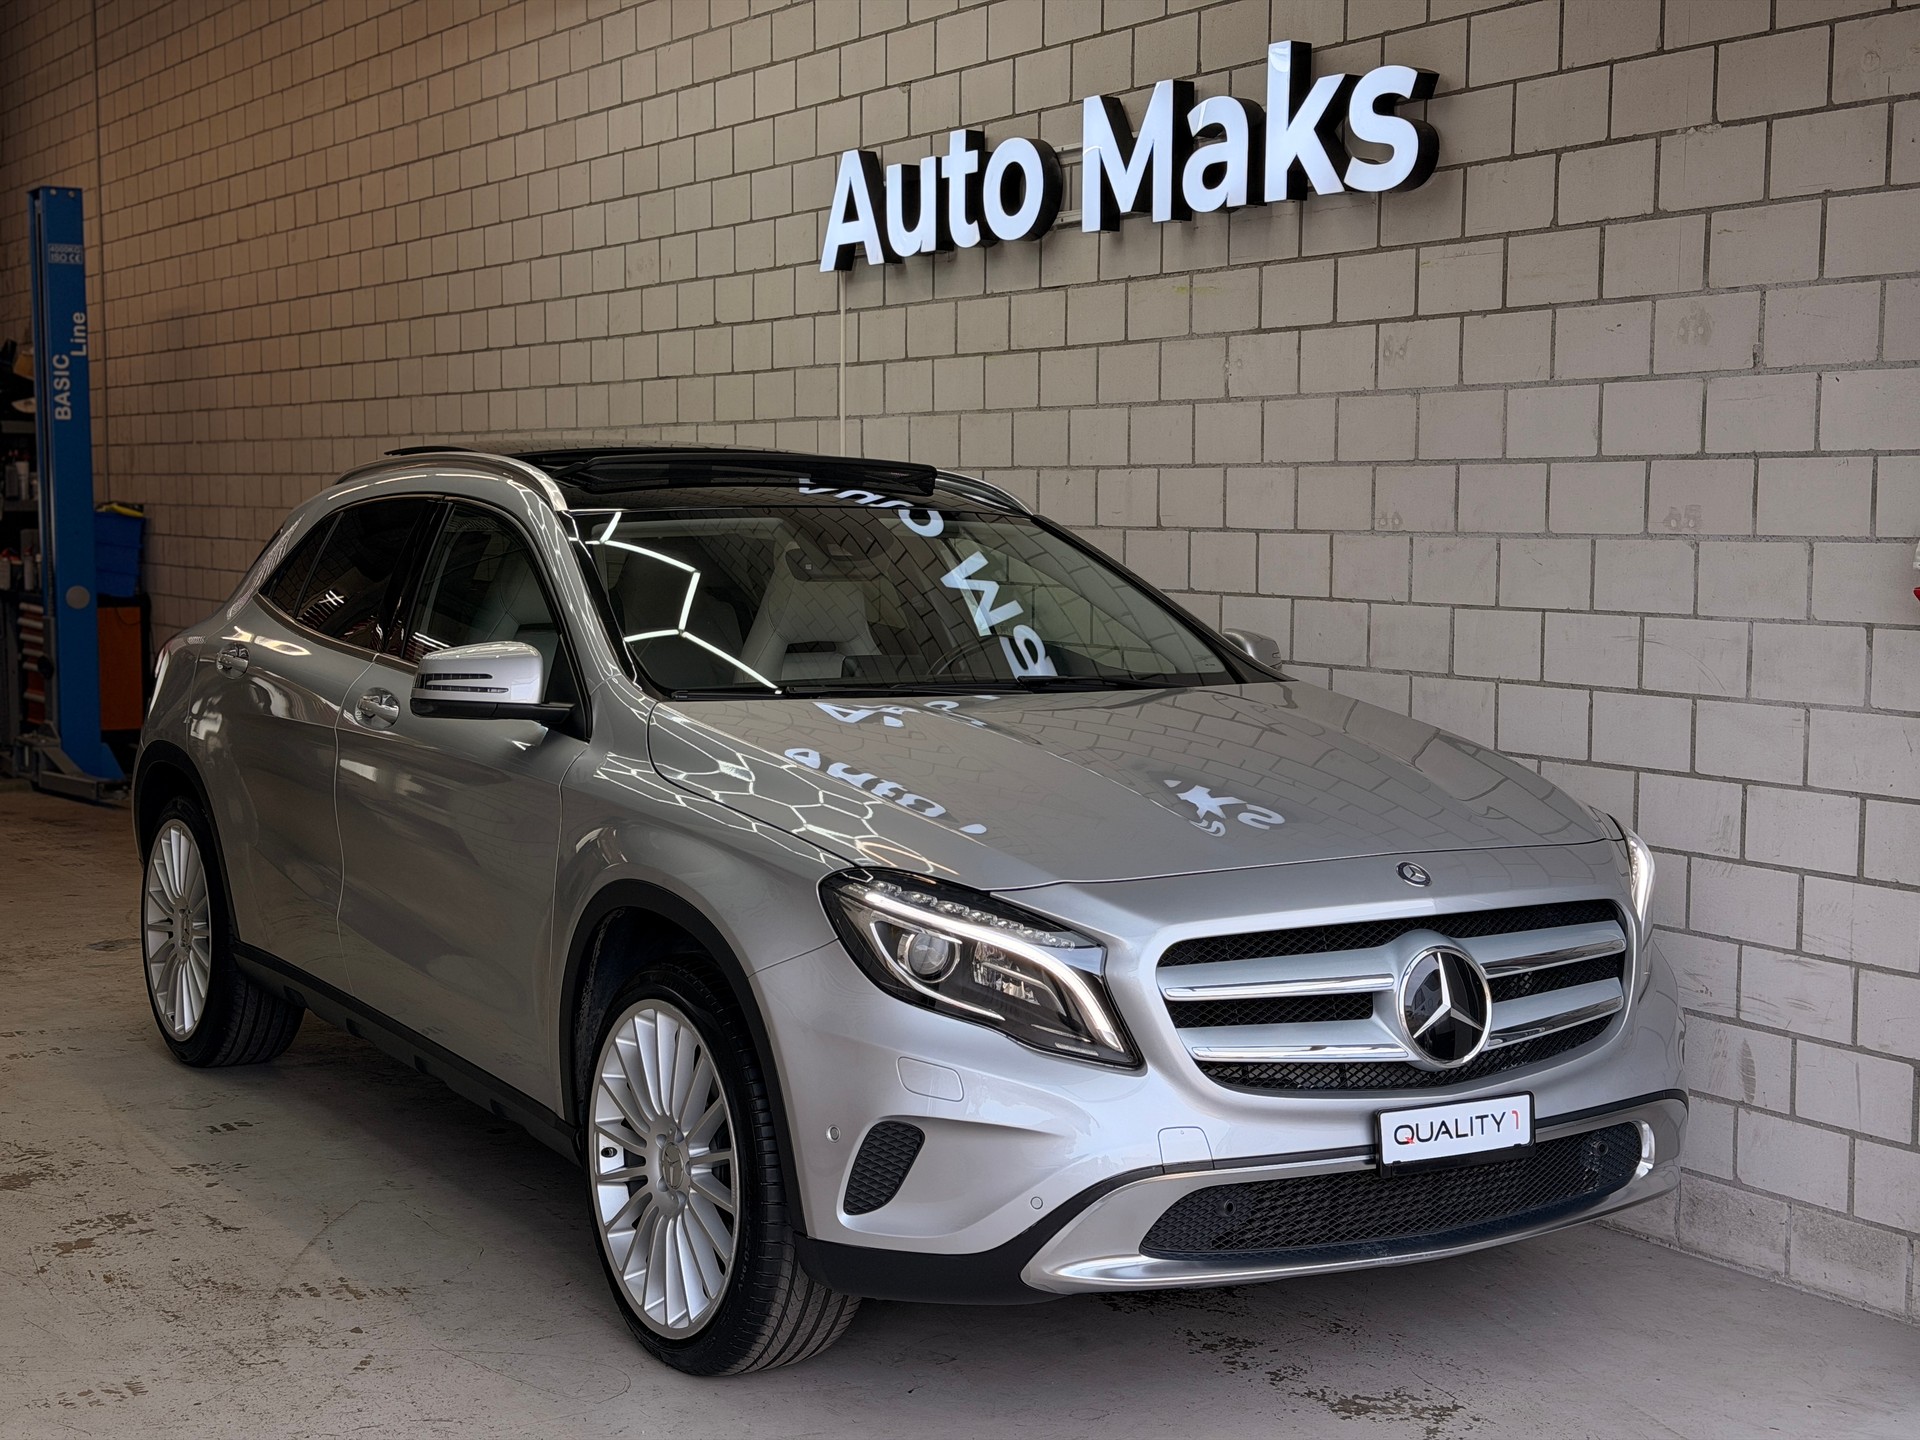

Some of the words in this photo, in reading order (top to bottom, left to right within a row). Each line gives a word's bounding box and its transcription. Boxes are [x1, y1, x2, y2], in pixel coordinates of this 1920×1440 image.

[820, 129, 1048, 272] Auto
[1081, 40, 1424, 233] Maks
[70, 311, 87, 357] Line
[52, 353, 71, 420] BASIC
[1393, 1111, 1506, 1145] QUALITY
